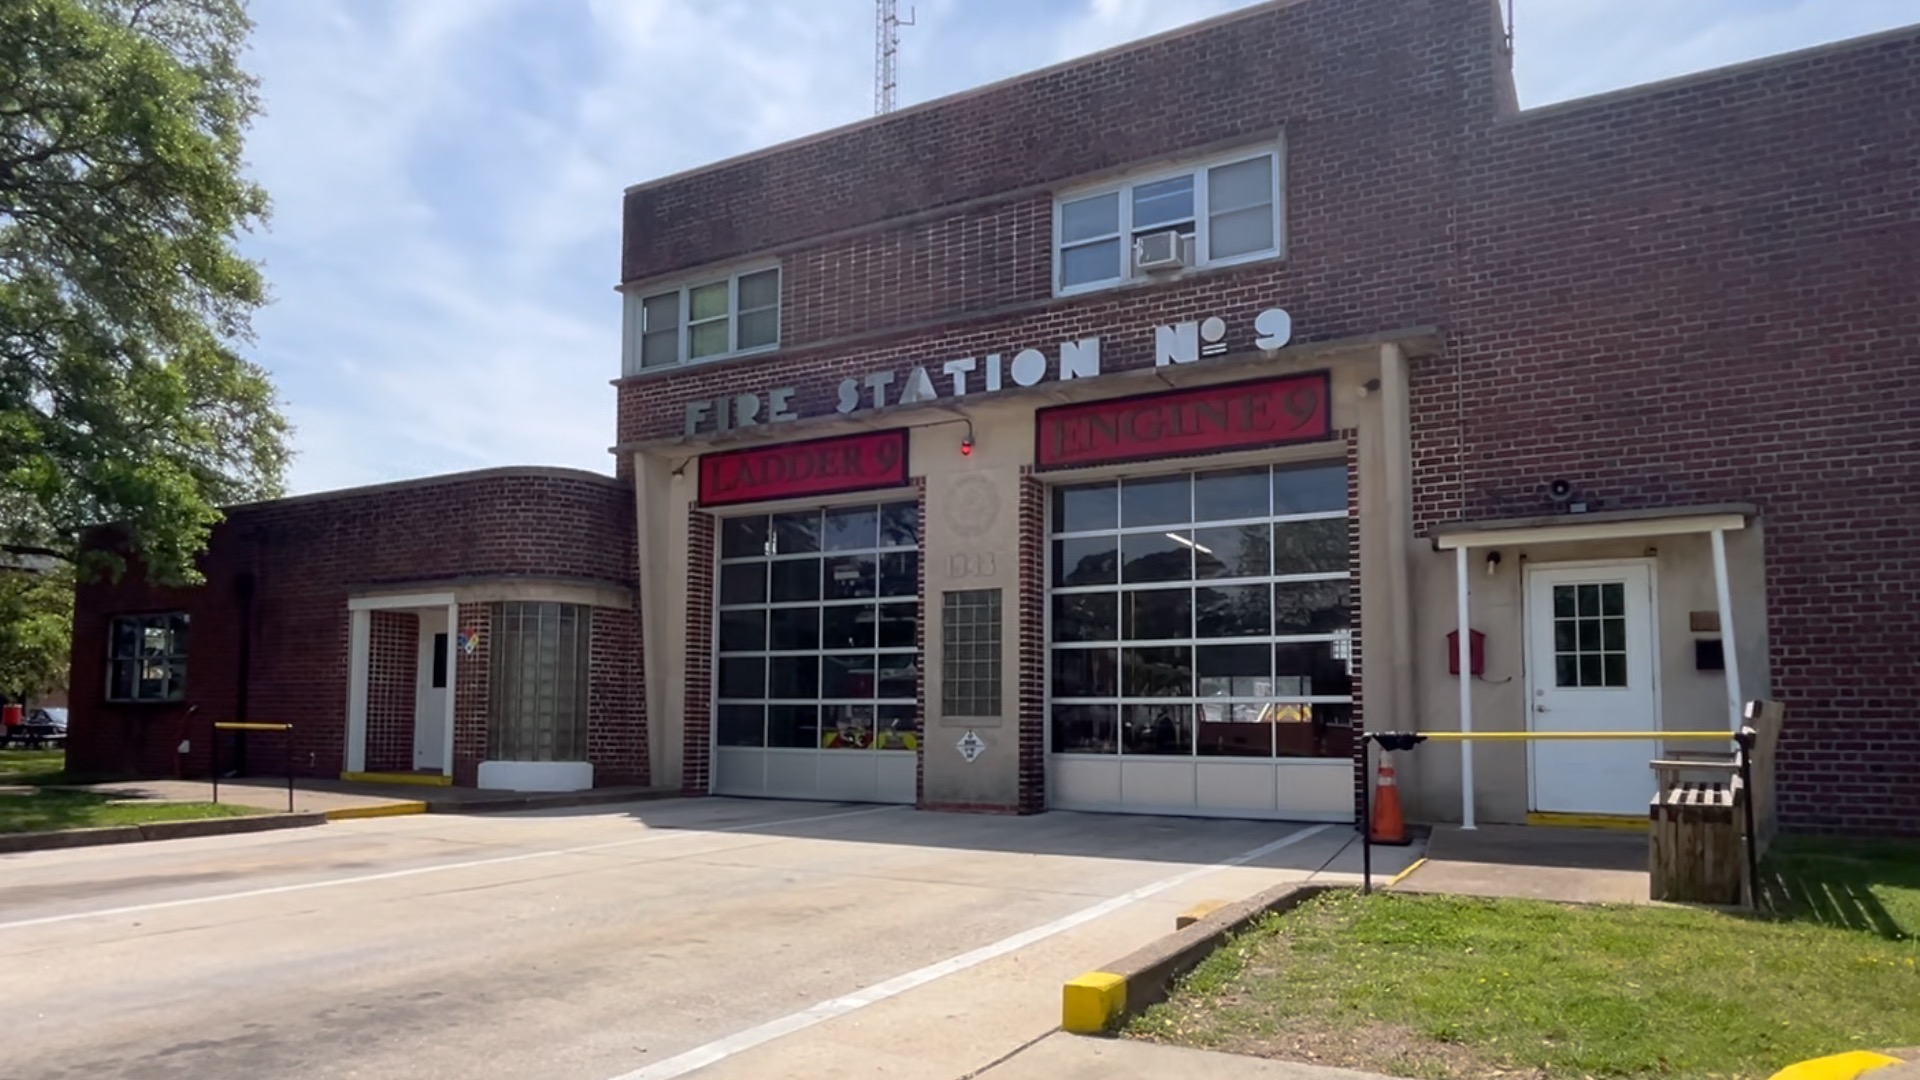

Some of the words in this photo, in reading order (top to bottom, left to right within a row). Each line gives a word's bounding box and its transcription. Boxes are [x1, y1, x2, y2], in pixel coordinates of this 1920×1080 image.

[685, 388, 798, 435] FIRE
[835, 337, 1100, 414] STATION
[1254, 307, 1292, 351] 9
[1054, 391, 1276, 456] ENGINE
[1283, 384, 1319, 432] 9
[711, 446, 866, 494] LADDER
[876, 439, 900, 474] 9
